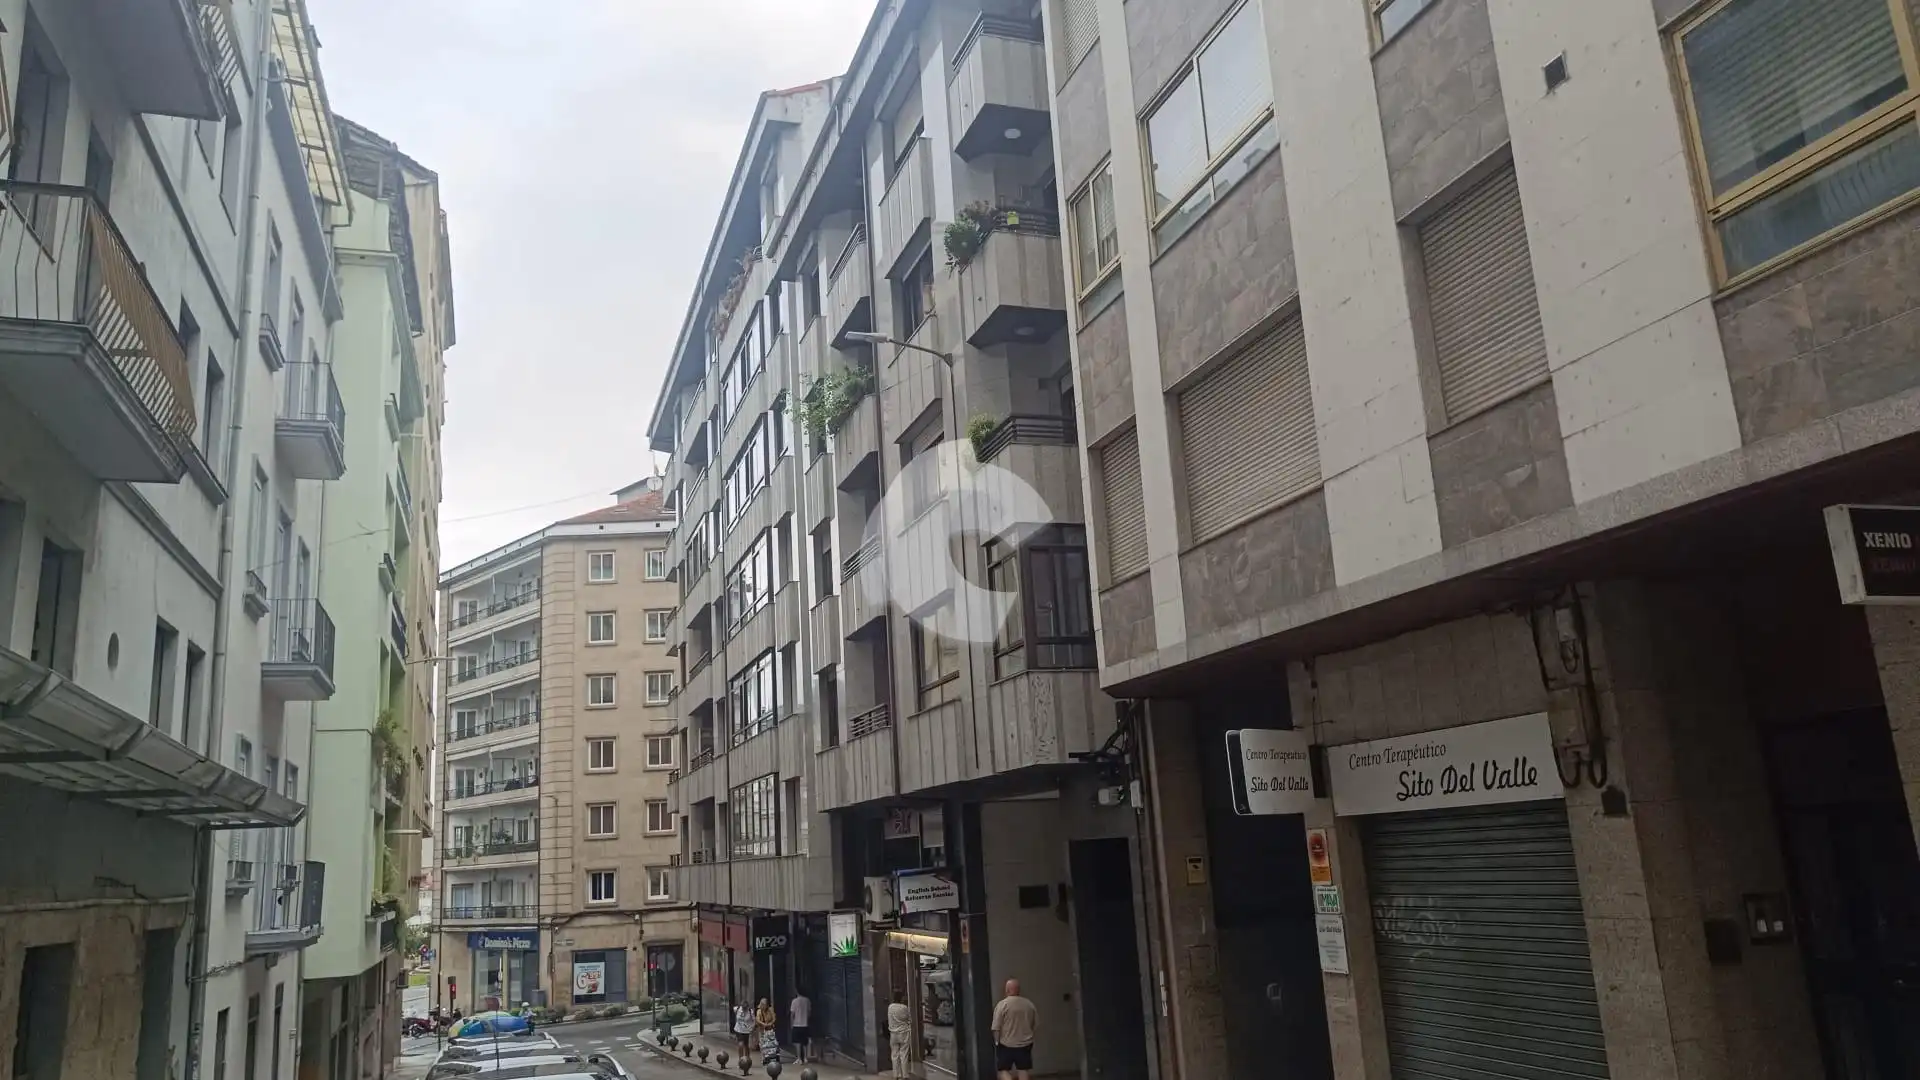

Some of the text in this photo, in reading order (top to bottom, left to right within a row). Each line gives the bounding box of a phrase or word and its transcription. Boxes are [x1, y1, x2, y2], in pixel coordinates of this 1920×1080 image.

[1863, 531, 1912, 549] XENIO
[1246, 748, 1268, 761] Centro
[1349, 742, 1447, 770] Centro Terapéutico
[1251, 776, 1309, 792] Sito Del Valle
[1396, 756, 1538, 801] Sito Del Valle
